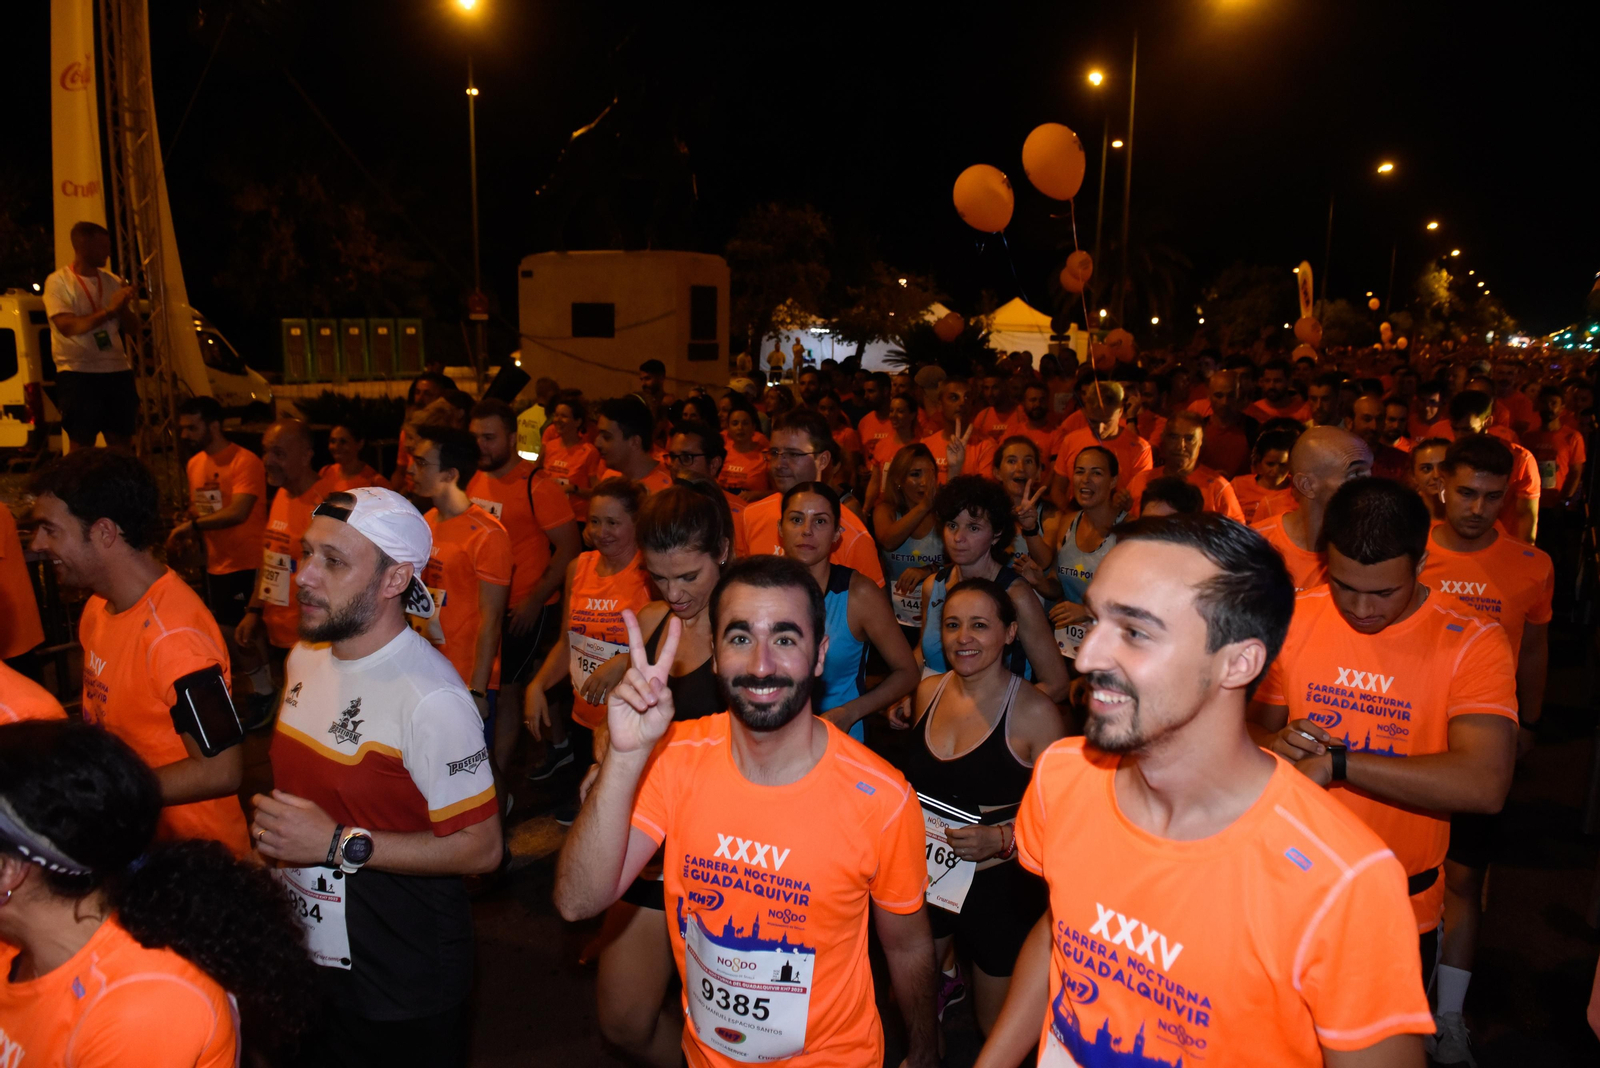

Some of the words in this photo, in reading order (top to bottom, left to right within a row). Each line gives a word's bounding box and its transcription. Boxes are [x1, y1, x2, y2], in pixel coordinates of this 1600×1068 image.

[891, 554, 916, 562] BETTA
[1440, 579, 1488, 596] XXXV
[1459, 595, 1502, 605] NOCTURNA
[585, 597, 619, 611] XXXV
[577, 656, 601, 674] 185
[1333, 666, 1395, 694] XXXV
[1307, 682, 1355, 699] CARRERA
[1359, 692, 1413, 710] NOCTURNA
[1312, 693, 1412, 722] GUADALQUIVIR
[450, 750, 488, 773] POSEIDON
[713, 832, 791, 872] XXXV
[684, 853, 739, 875] CARRERA
[743, 867, 812, 893] NOCTURNA
[690, 868, 810, 907] GUADALQUIVIR
[1089, 901, 1184, 973] XXXV
[1057, 919, 1119, 964] CARRERA
[1126, 955, 1213, 1011] NOCTURNA
[732, 980, 742, 988] DEL
[742, 982, 780, 992] GUADALQUIVIR
[1062, 941, 1210, 1028] GUADALQUIVIR
[701, 976, 771, 1022] 9385
[705, 1006, 728, 1021] MANUEL
[727, 1015, 756, 1030] ESPACIO
[755, 1025, 783, 1036] SANTOS
